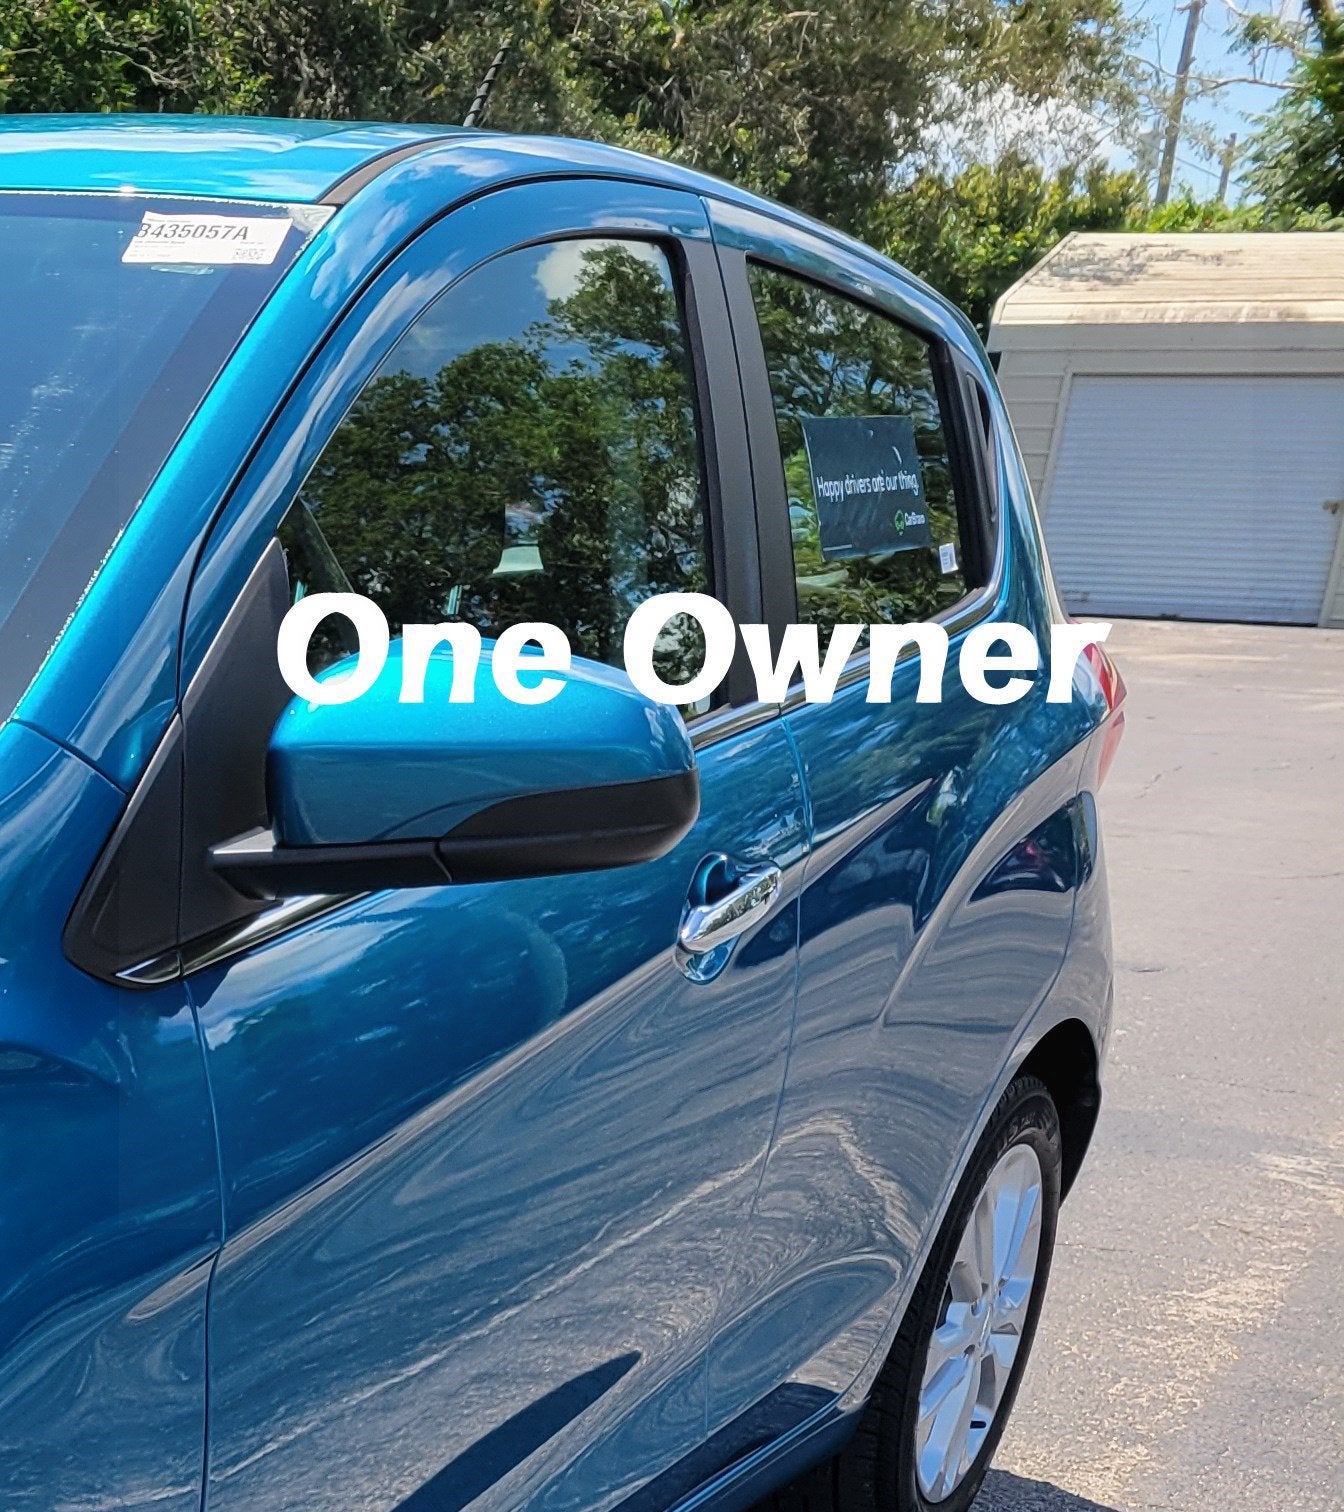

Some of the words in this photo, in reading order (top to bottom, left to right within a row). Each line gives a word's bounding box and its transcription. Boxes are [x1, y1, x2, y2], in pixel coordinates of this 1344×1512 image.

[816, 476, 844, 502] Happy
[845, 474, 872, 495] drivers
[872, 476, 886, 492] are
[886, 476, 898, 491] our
